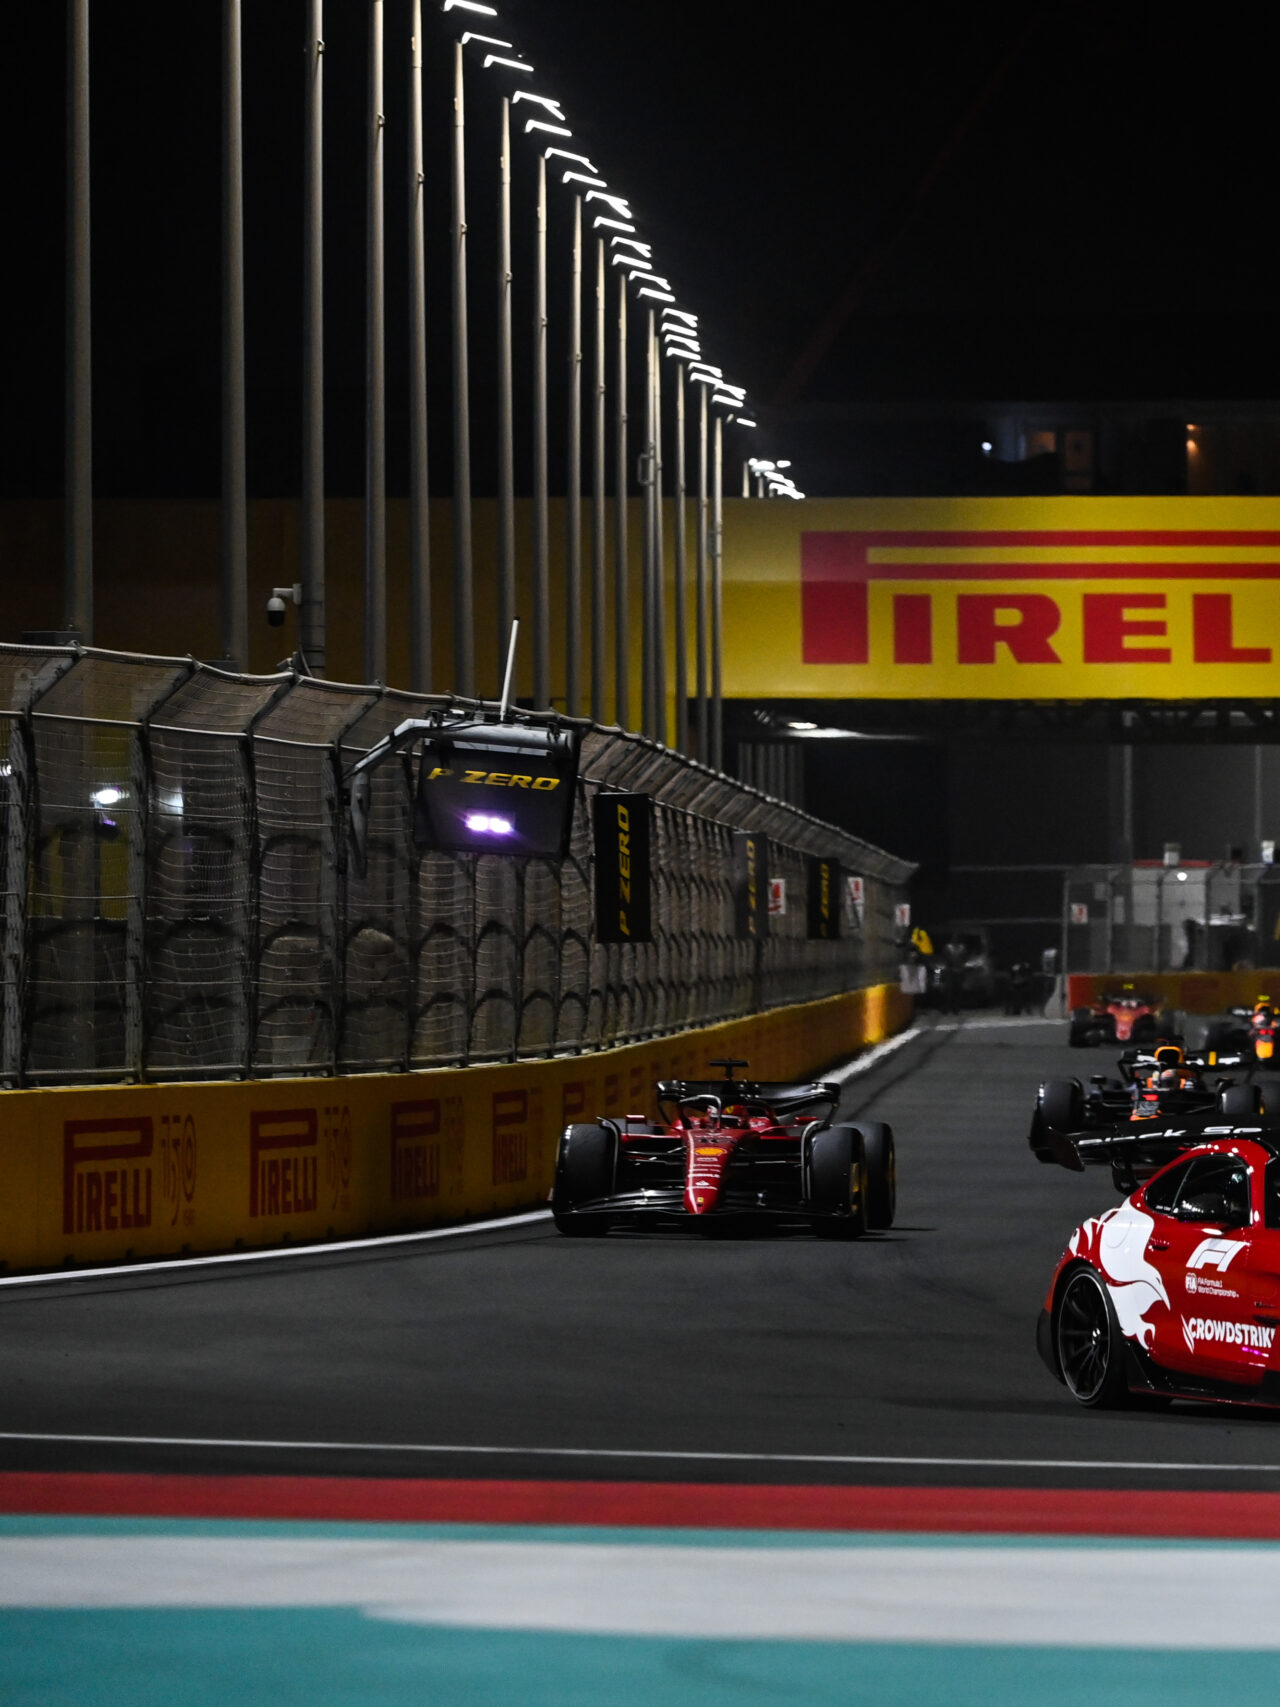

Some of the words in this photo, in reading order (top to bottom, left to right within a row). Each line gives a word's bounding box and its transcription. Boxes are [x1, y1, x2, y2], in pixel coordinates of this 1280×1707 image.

[427, 767, 454, 780] P
[459, 770, 561, 791] ZERO
[616, 804, 631, 904] ZERO
[618, 910, 631, 936] P
[63, 1116, 154, 1234] PIRELLI
[250, 1107, 319, 1218] PIRELLI
[1189, 1317, 1276, 1348] CROWDSTRIK
